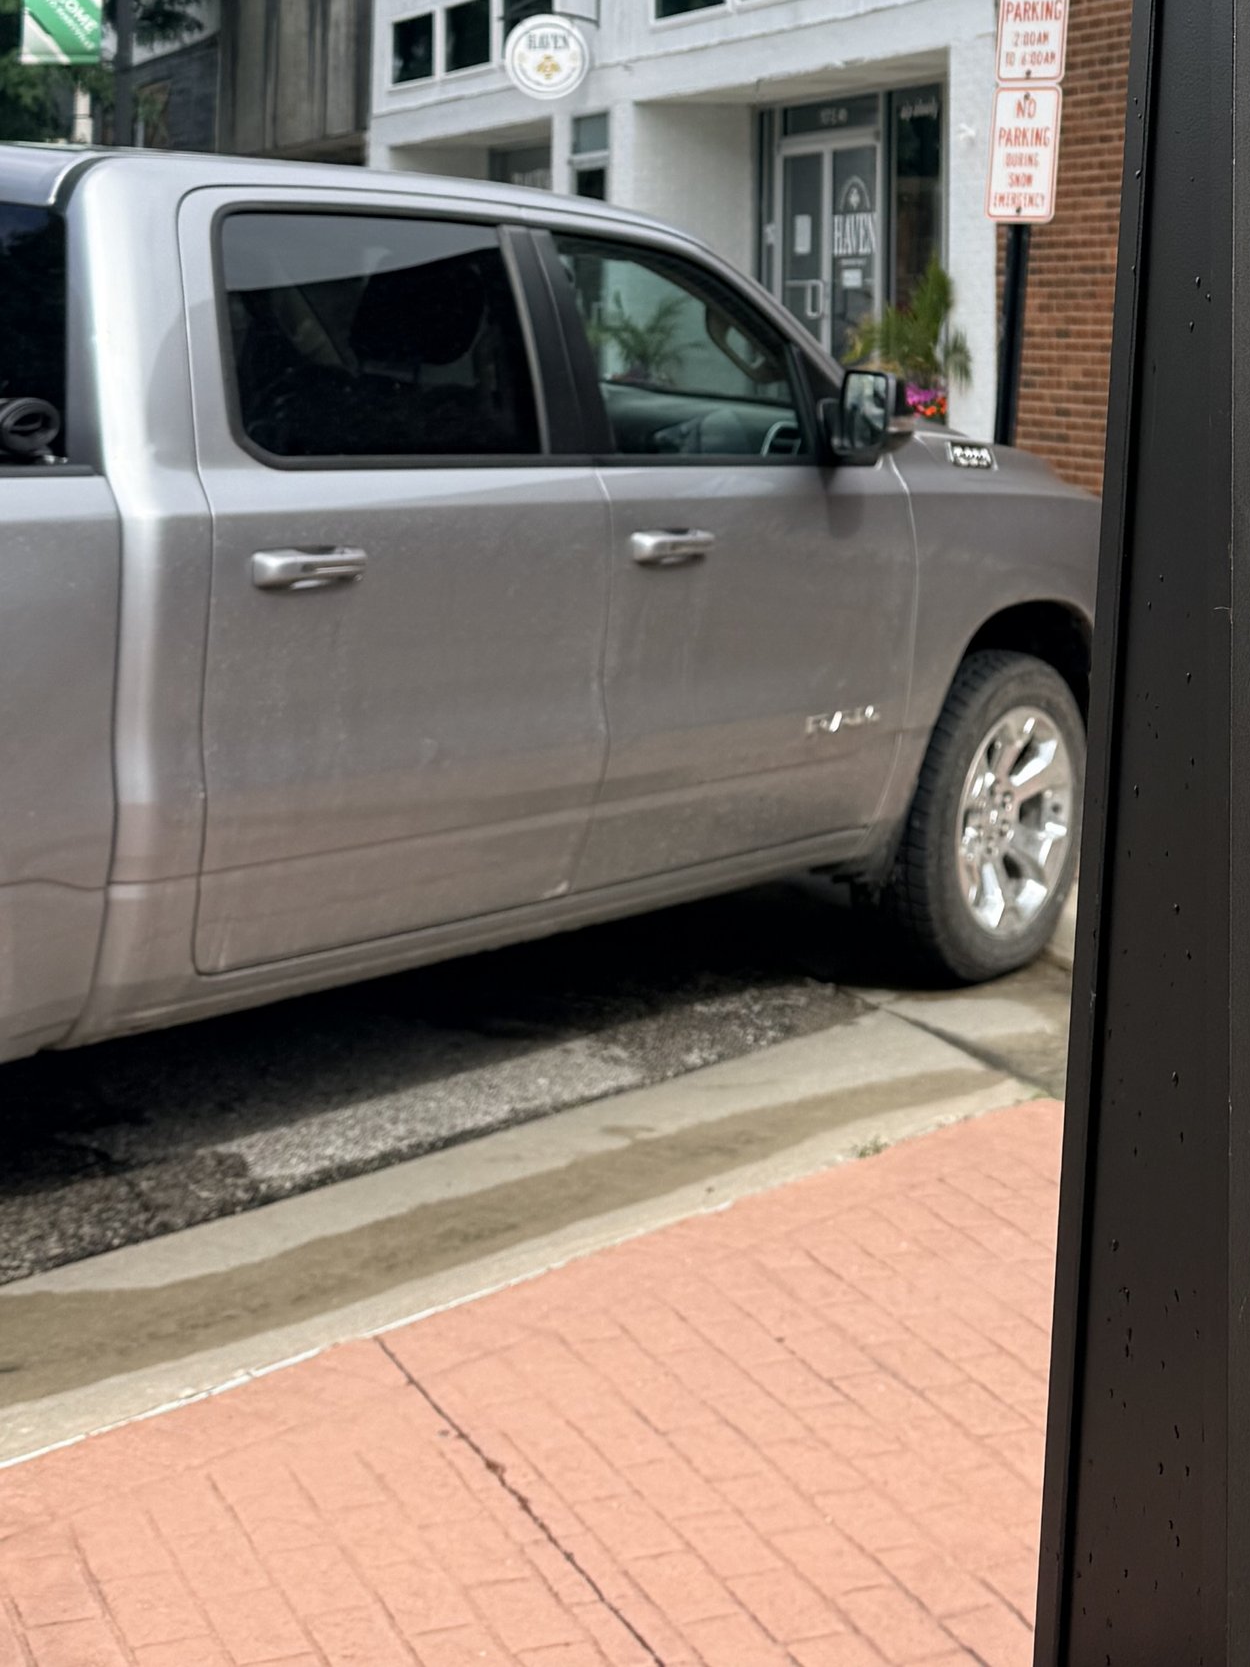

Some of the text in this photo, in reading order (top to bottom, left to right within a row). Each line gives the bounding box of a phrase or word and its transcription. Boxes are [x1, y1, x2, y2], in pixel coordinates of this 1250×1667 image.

[1005, 0, 1062, 22] PARKING
[527, 33, 570, 50] HAVEN
[1006, 51, 1016, 66] TO
[1015, 98, 1037, 120] NO
[998, 126, 1051, 148] PARKING
[1005, 152, 1039, 168] DURING
[1008, 172, 1033, 188] SNOW
[993, 192, 1045, 209] EMERGENCY
[834, 212, 876, 256] HAVEN
